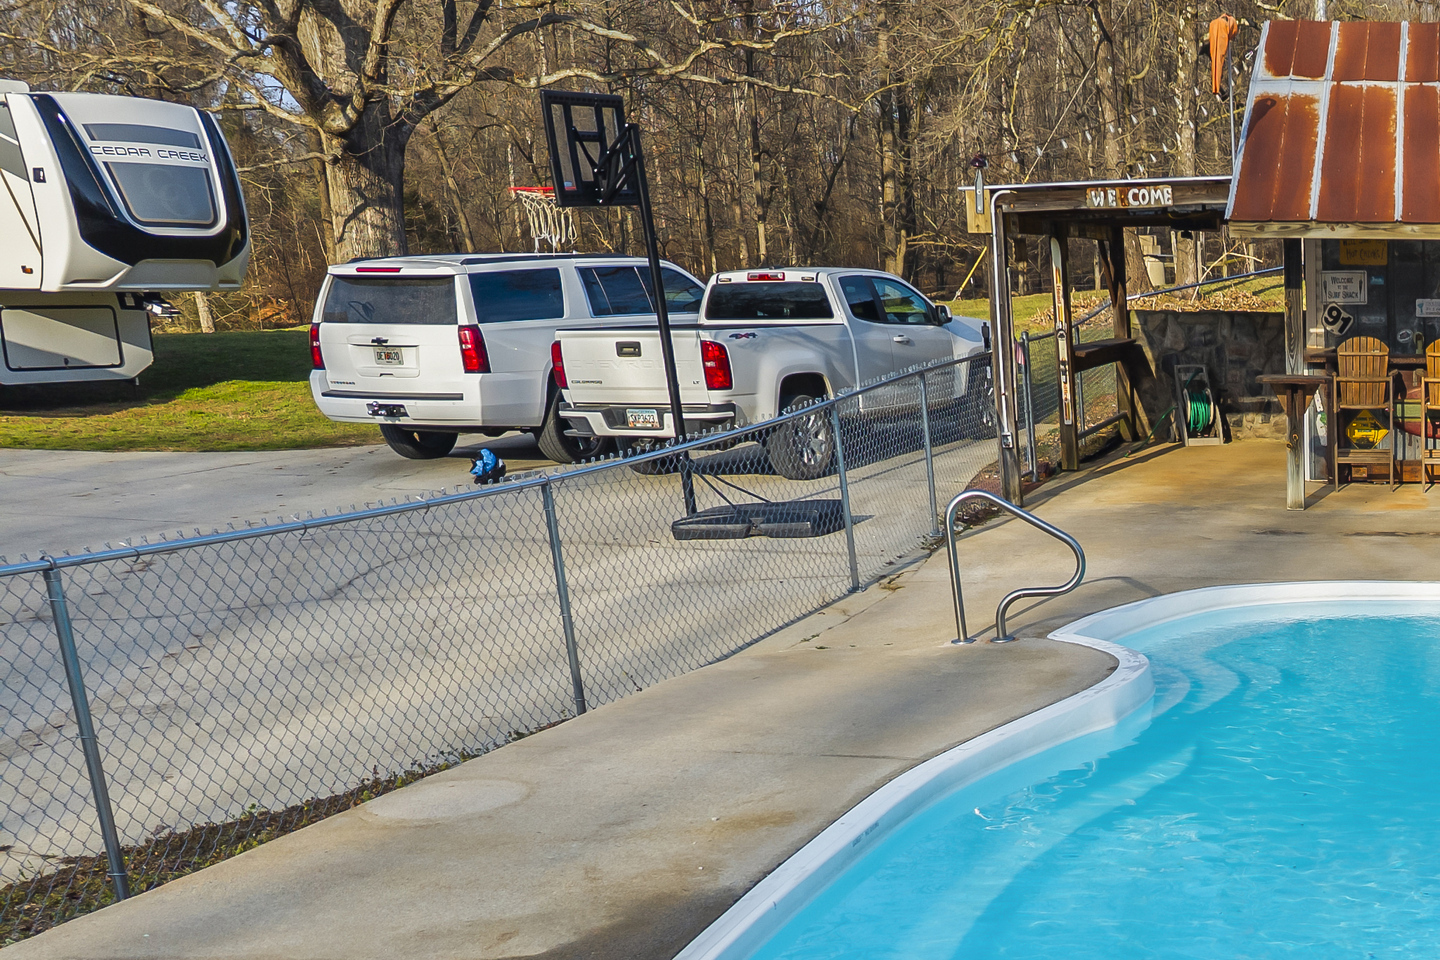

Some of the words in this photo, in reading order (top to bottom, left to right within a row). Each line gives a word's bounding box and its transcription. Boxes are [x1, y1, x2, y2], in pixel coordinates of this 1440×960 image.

[89, 145, 151, 157] CEDAR
[157, 149, 209, 162] CREEK
[1331, 276, 1353, 284] WELCOME
[1328, 290, 1341, 299] SURF
[1342, 290, 1358, 299] SHACK
[1324, 306, 1352, 334] 91
